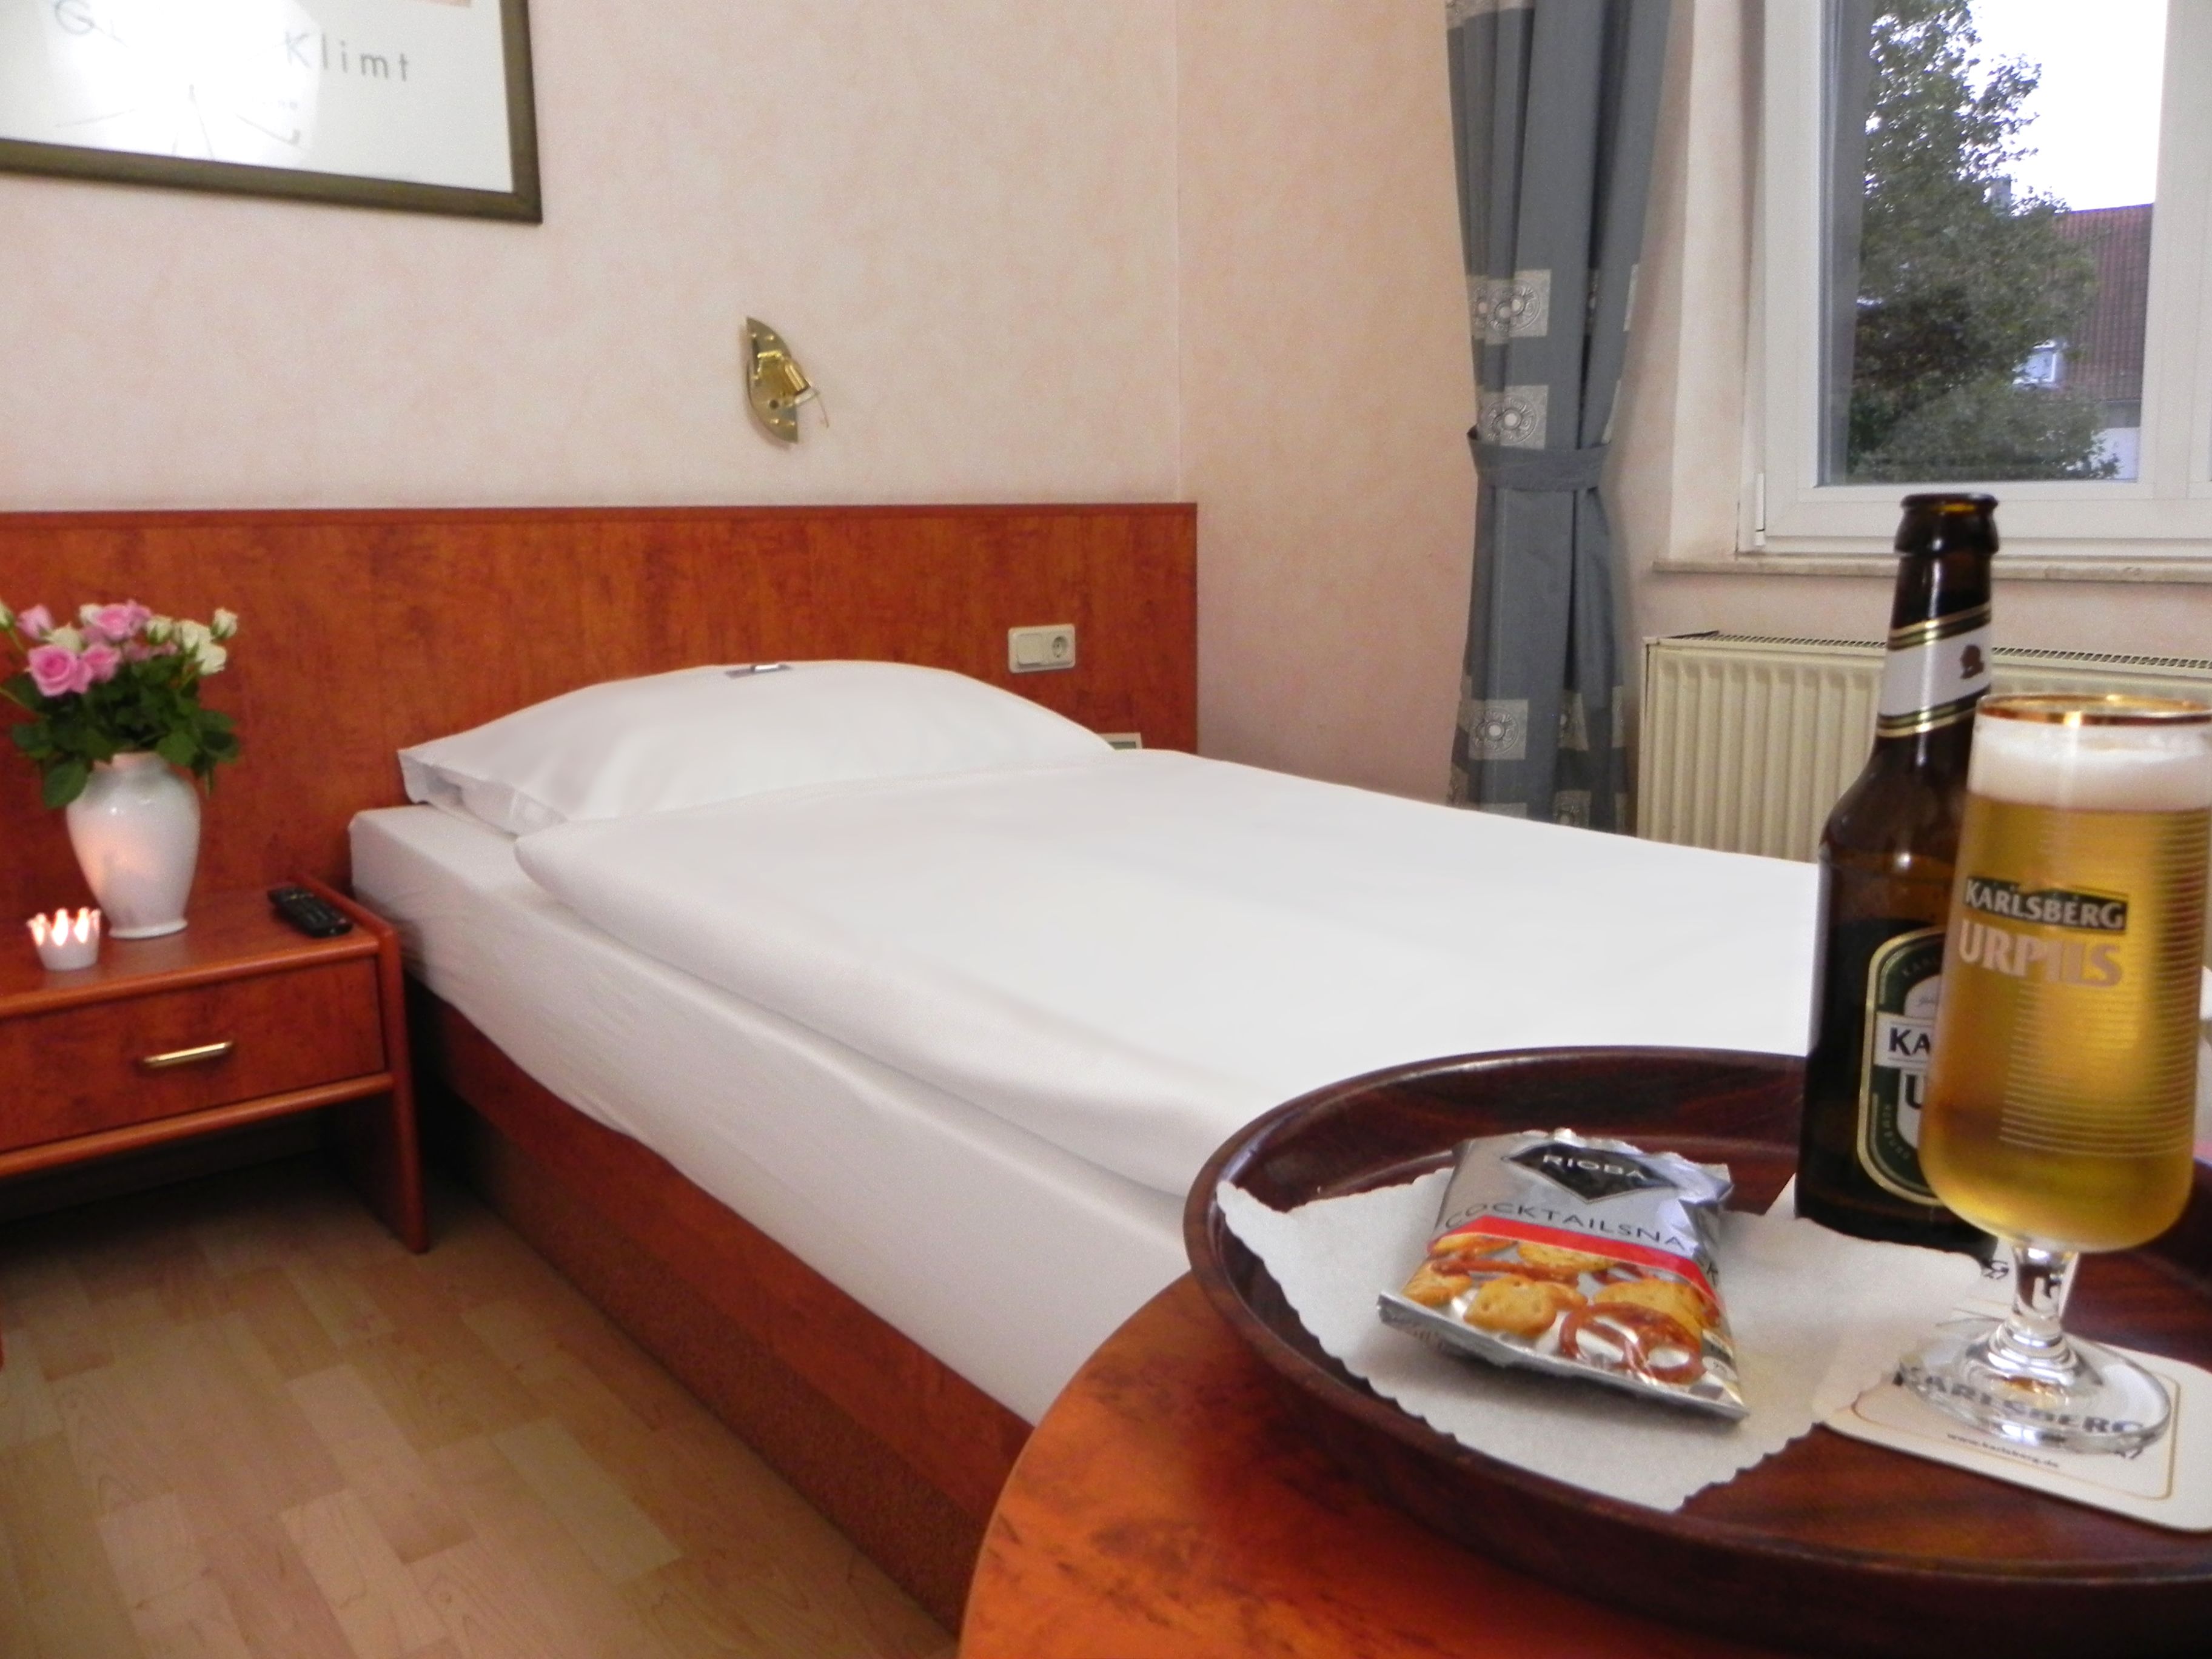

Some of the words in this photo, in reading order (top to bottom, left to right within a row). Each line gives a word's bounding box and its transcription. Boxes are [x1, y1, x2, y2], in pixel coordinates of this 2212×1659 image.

[285, 31, 409, 81] Klimt
[1966, 879, 2125, 929] KARLSBERG
[1959, 918, 2122, 988] URPILS
[1543, 1154, 1648, 1181] RIOBA
